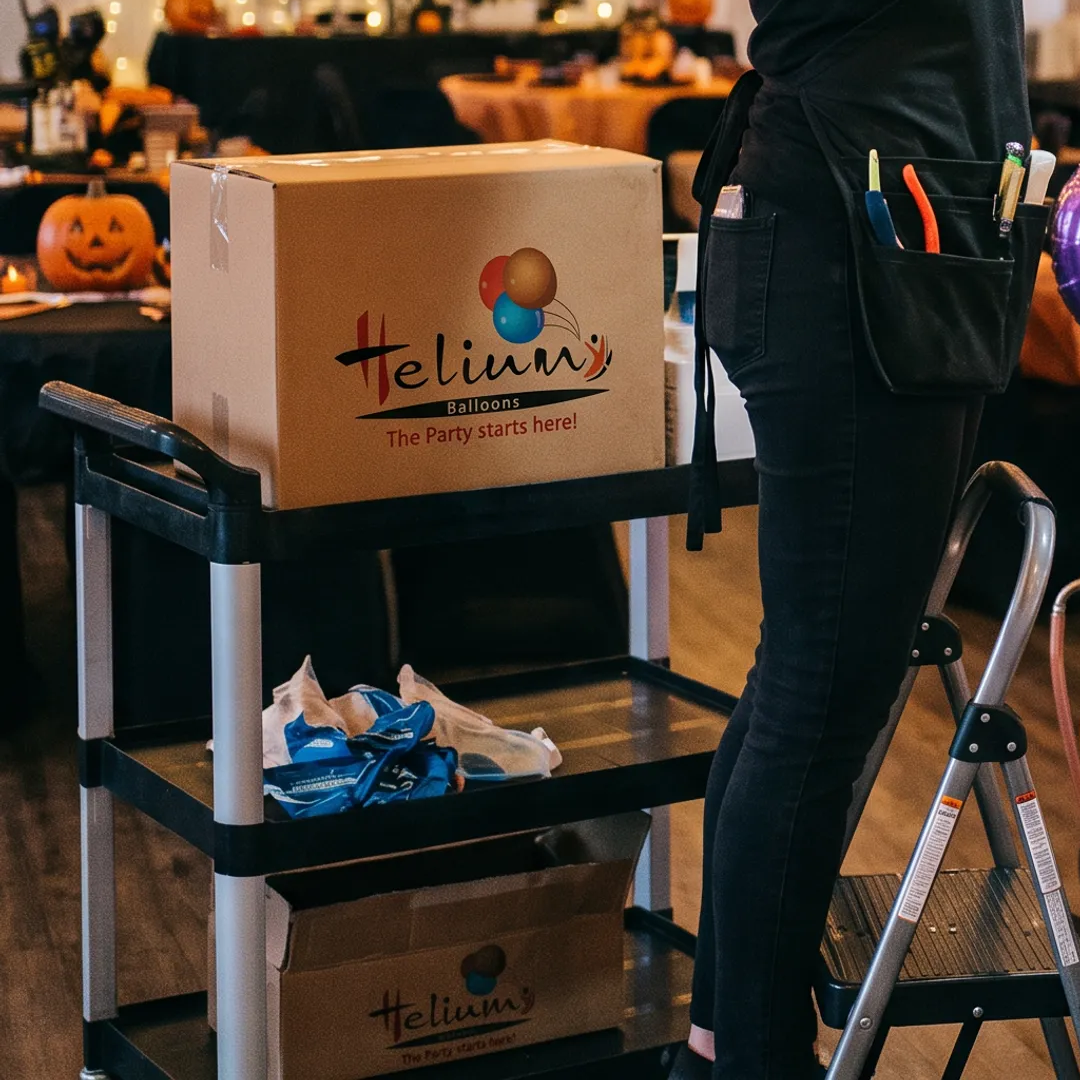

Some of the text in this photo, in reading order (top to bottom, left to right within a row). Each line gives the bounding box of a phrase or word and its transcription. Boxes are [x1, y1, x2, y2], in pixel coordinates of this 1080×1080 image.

[334, 310, 587, 406] Helium
[447, 396, 520, 415] Balloons
[387, 413, 577, 448] The Party starts here!
